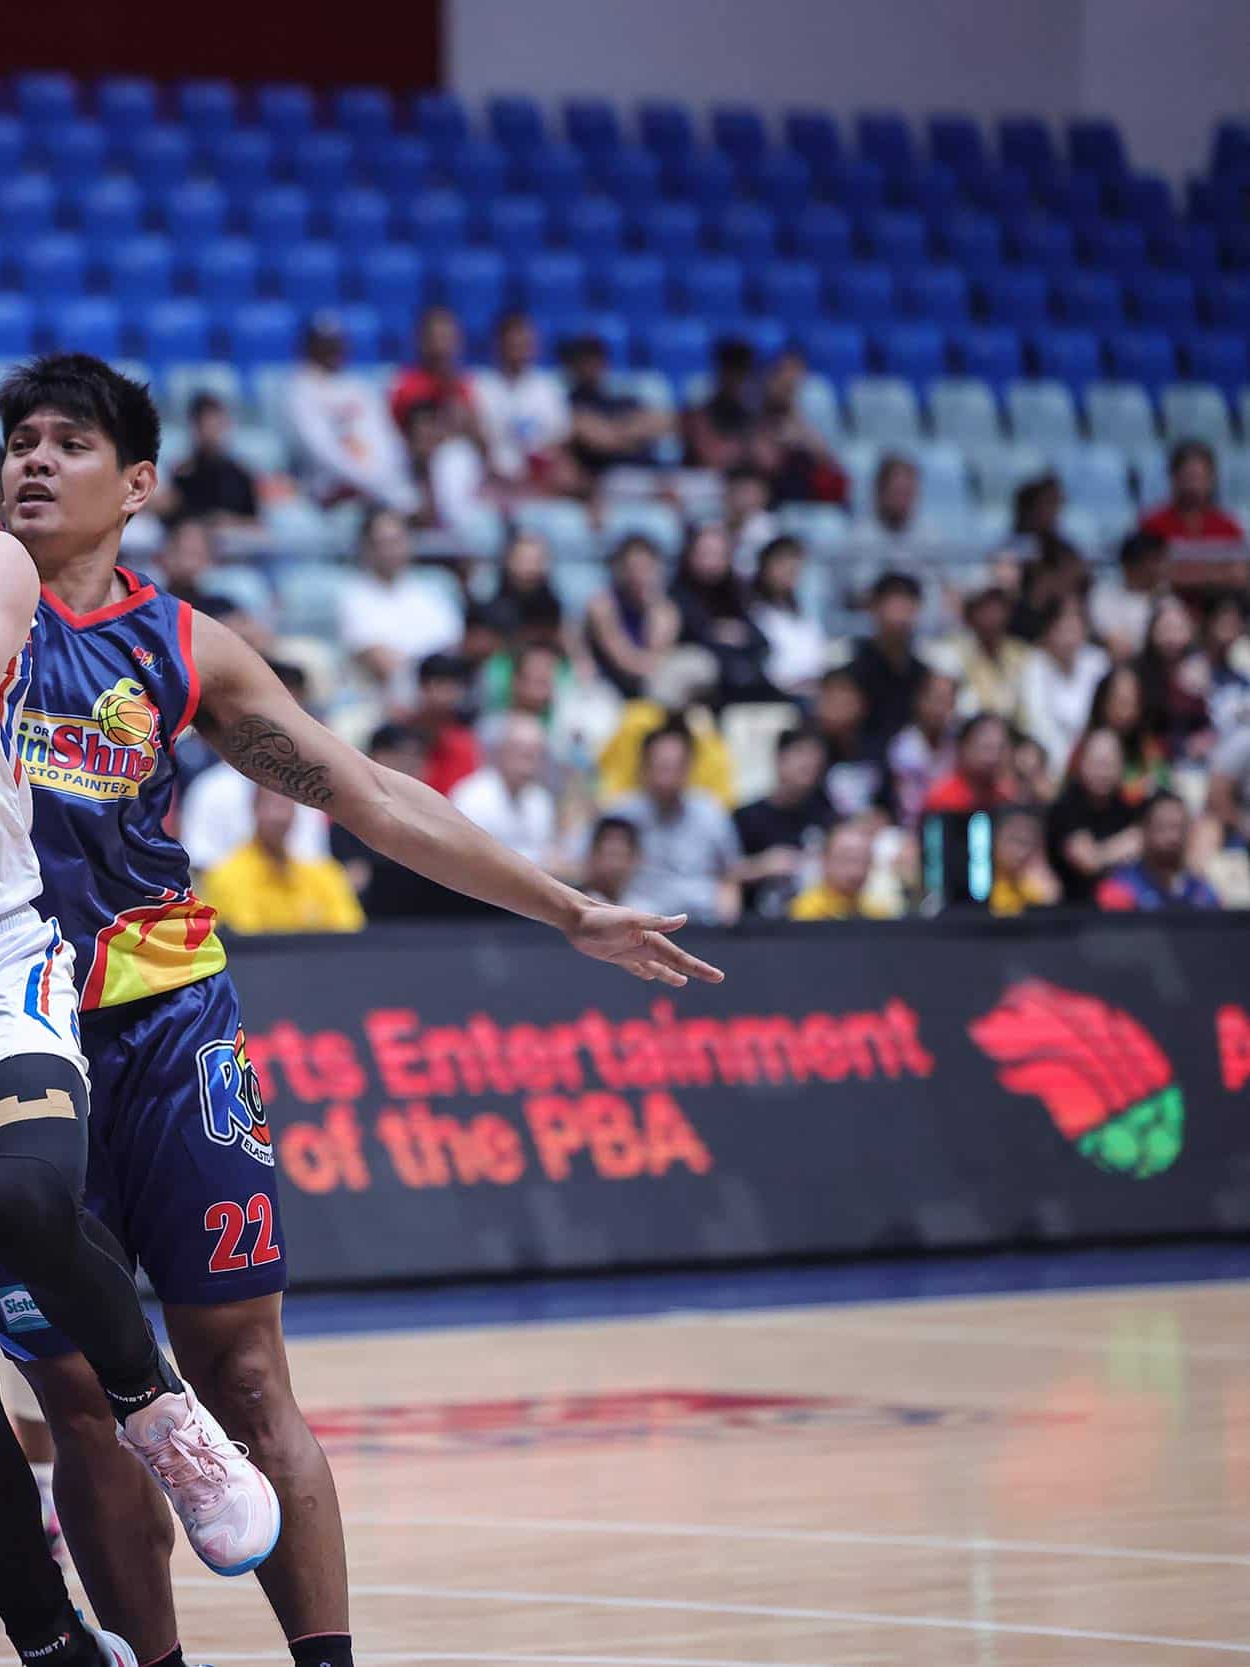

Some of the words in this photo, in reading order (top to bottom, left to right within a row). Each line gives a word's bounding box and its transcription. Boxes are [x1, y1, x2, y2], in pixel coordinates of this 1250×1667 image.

[362, 1005, 936, 1098] Entertainment
[280, 1102, 372, 1195] of
[376, 1100, 526, 1190] the
[522, 1090, 714, 1183] PBA
[204, 1192, 281, 1273] 22
